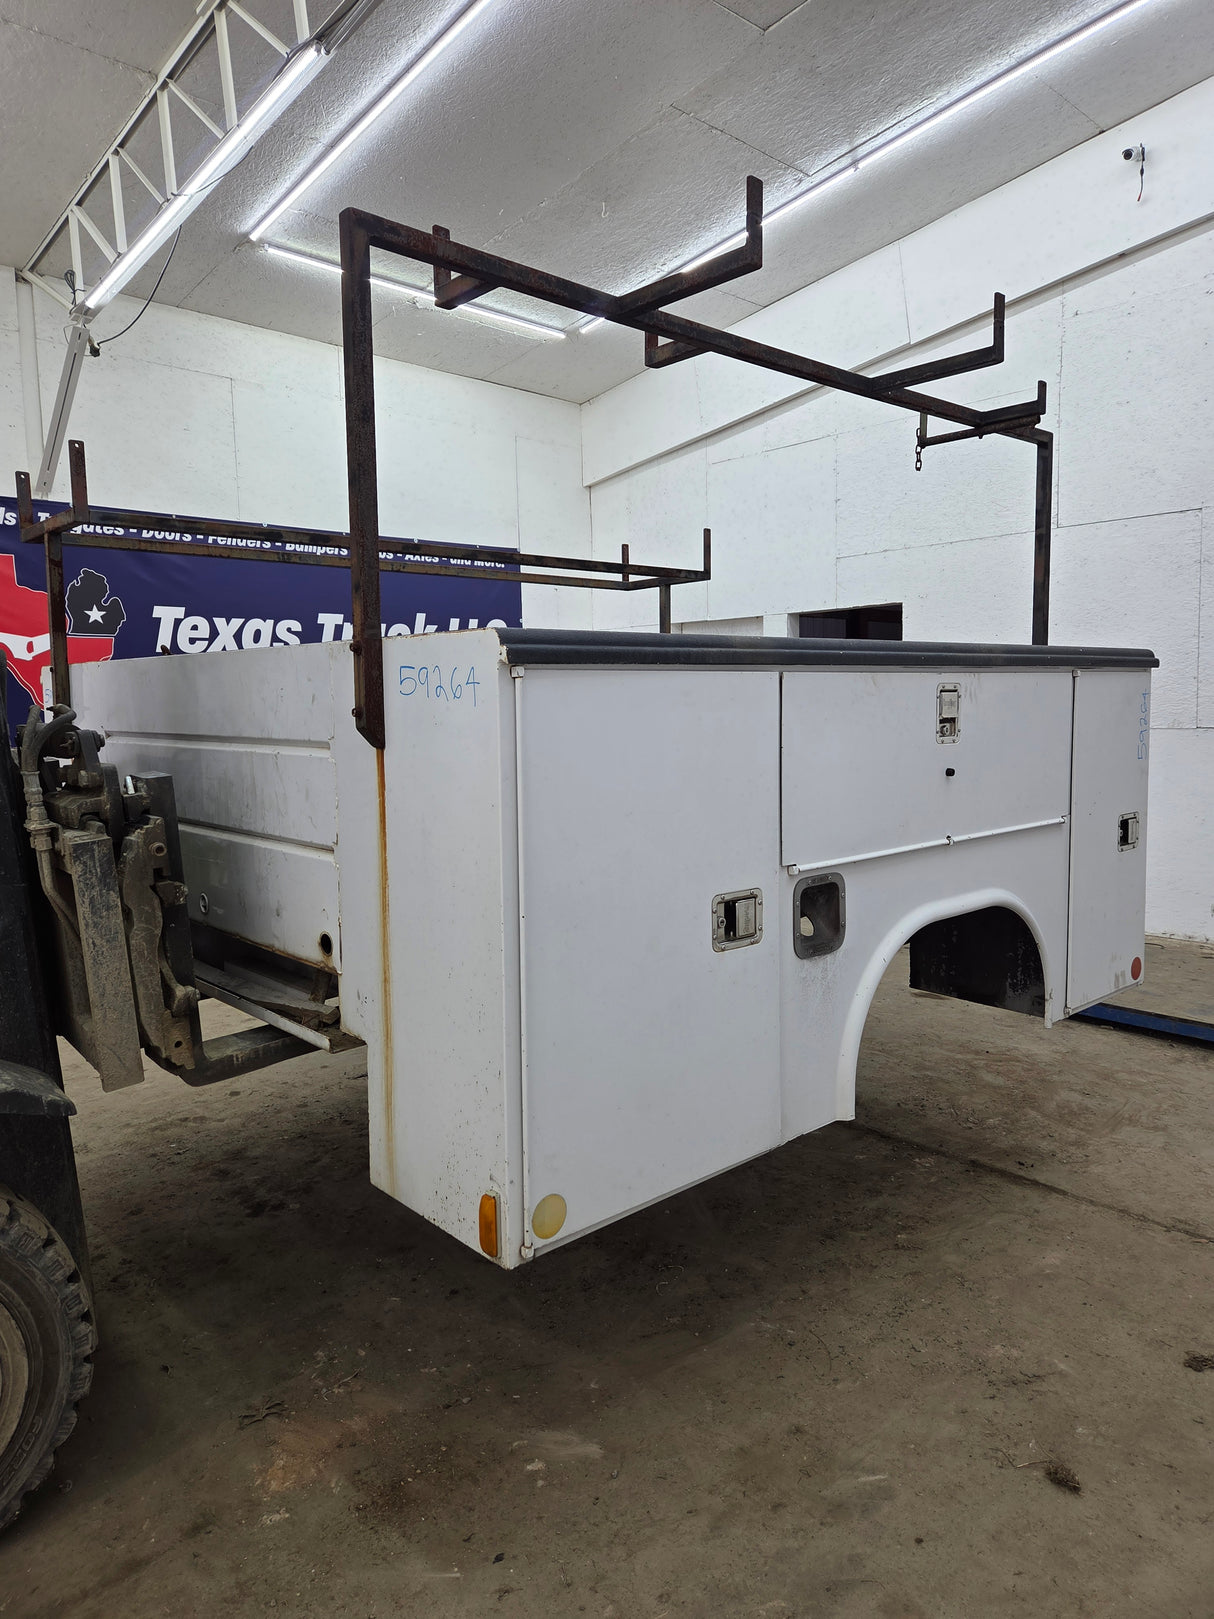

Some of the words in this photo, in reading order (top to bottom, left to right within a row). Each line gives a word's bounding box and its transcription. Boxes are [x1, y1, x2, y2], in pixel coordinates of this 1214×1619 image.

[152, 605, 303, 654] Texas
[399, 664, 481, 708] 59264
[1137, 688, 1149, 760] 59264
